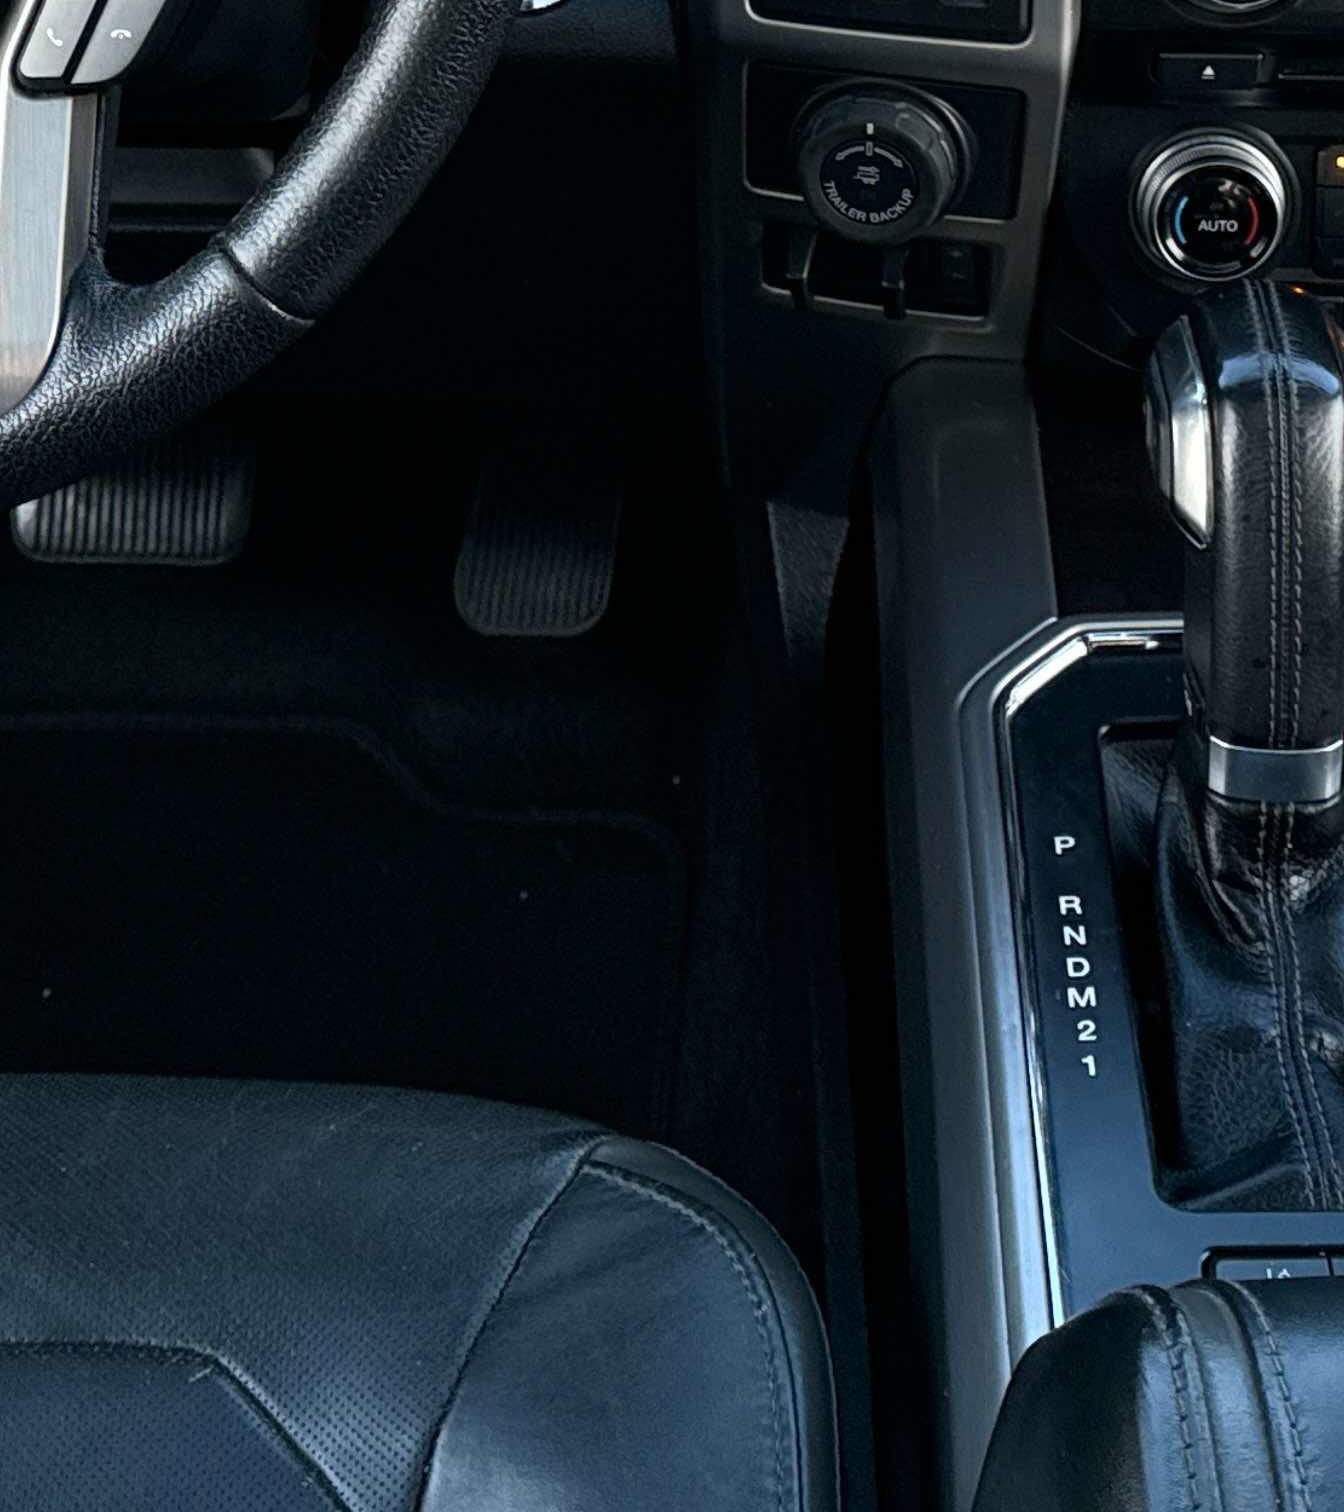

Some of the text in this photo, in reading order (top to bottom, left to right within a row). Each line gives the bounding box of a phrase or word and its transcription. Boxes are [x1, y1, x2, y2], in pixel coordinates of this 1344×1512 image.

[823, 179, 915, 224] TRAILER BACKUP
[1197, 219, 1239, 233] AUTO
[1053, 835, 1076, 855] P
[1058, 895, 1083, 915] R
[1062, 925, 1088, 946] N
[1065, 956, 1091, 978] D
[1067, 986, 1097, 1008] M
[1076, 1019, 1098, 1042] 2
[1080, 1054, 1097, 1077] 1
